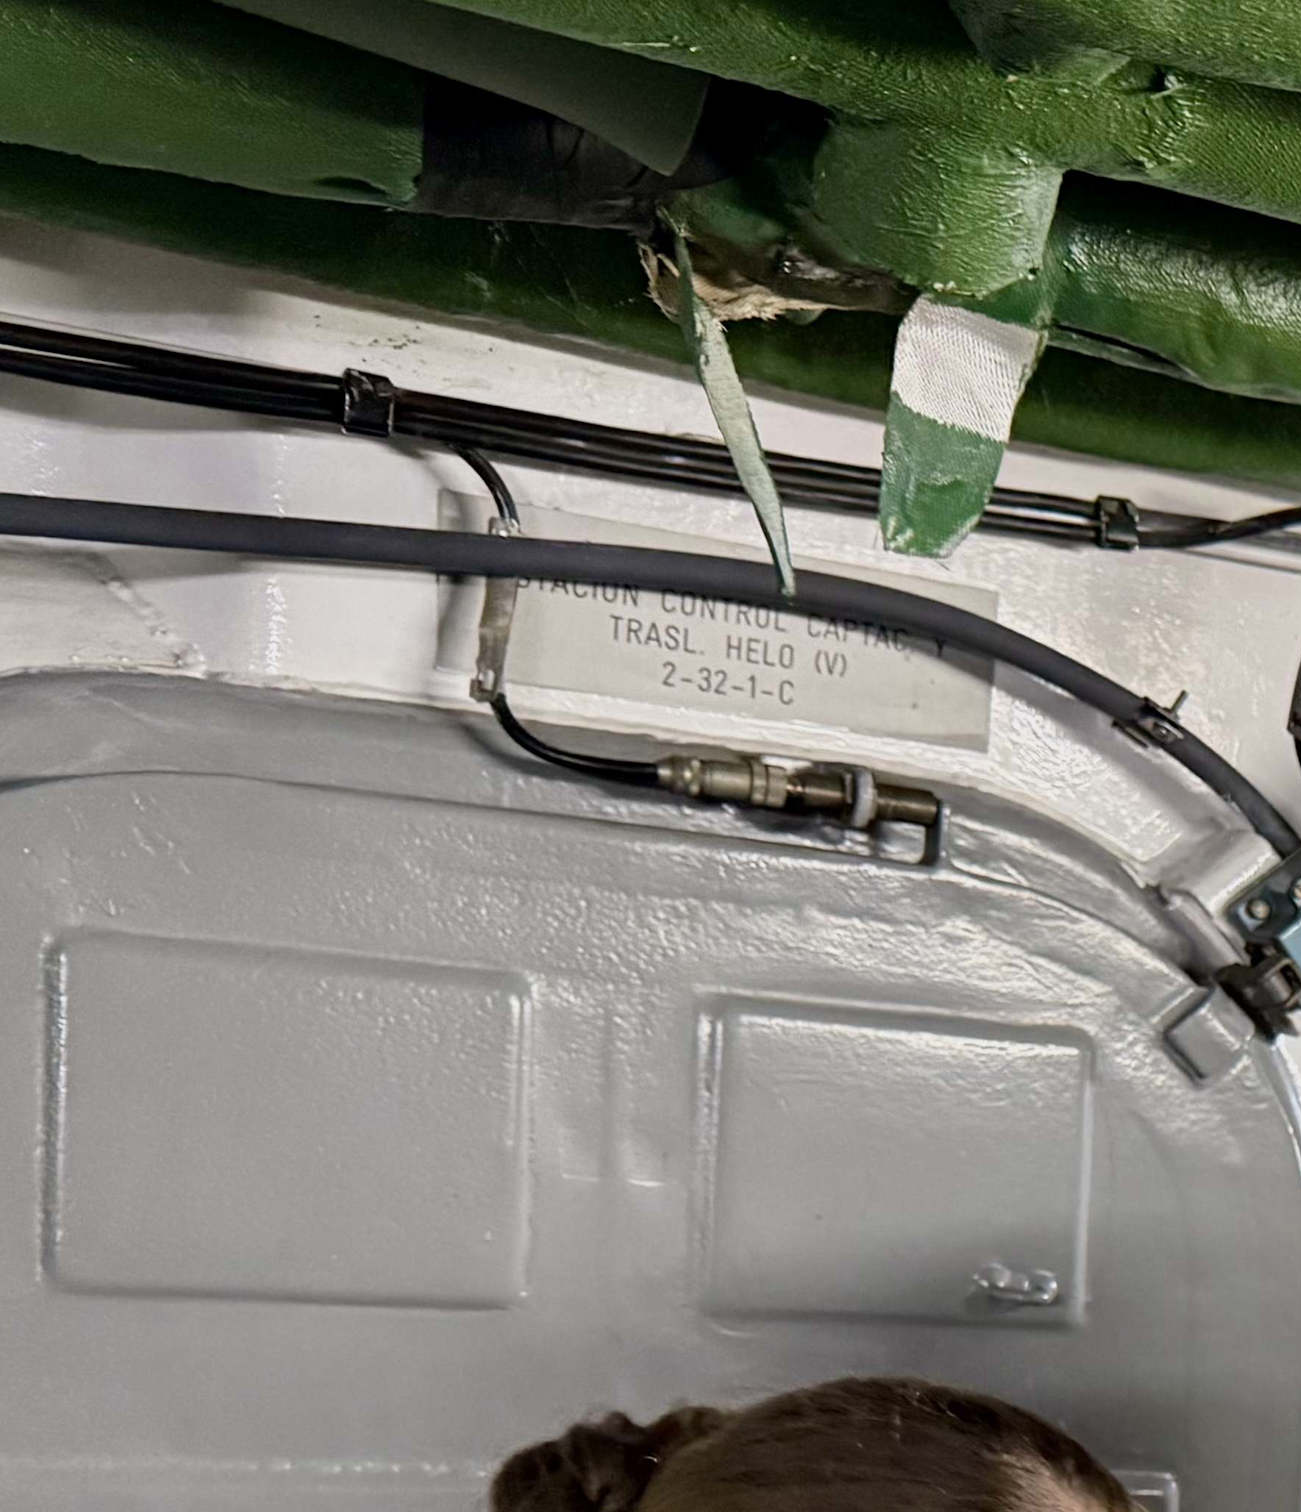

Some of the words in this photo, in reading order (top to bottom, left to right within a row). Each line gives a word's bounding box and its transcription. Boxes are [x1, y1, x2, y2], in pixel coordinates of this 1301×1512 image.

[610, 614, 704, 654] TRASL.
[726, 635, 794, 669] HELO
[814, 650, 848, 677] (V)
[661, 589, 787, 632] CONTROL
[934, 637, 947, 658] Y
[661, 661, 795, 705] 2-32-1-C
